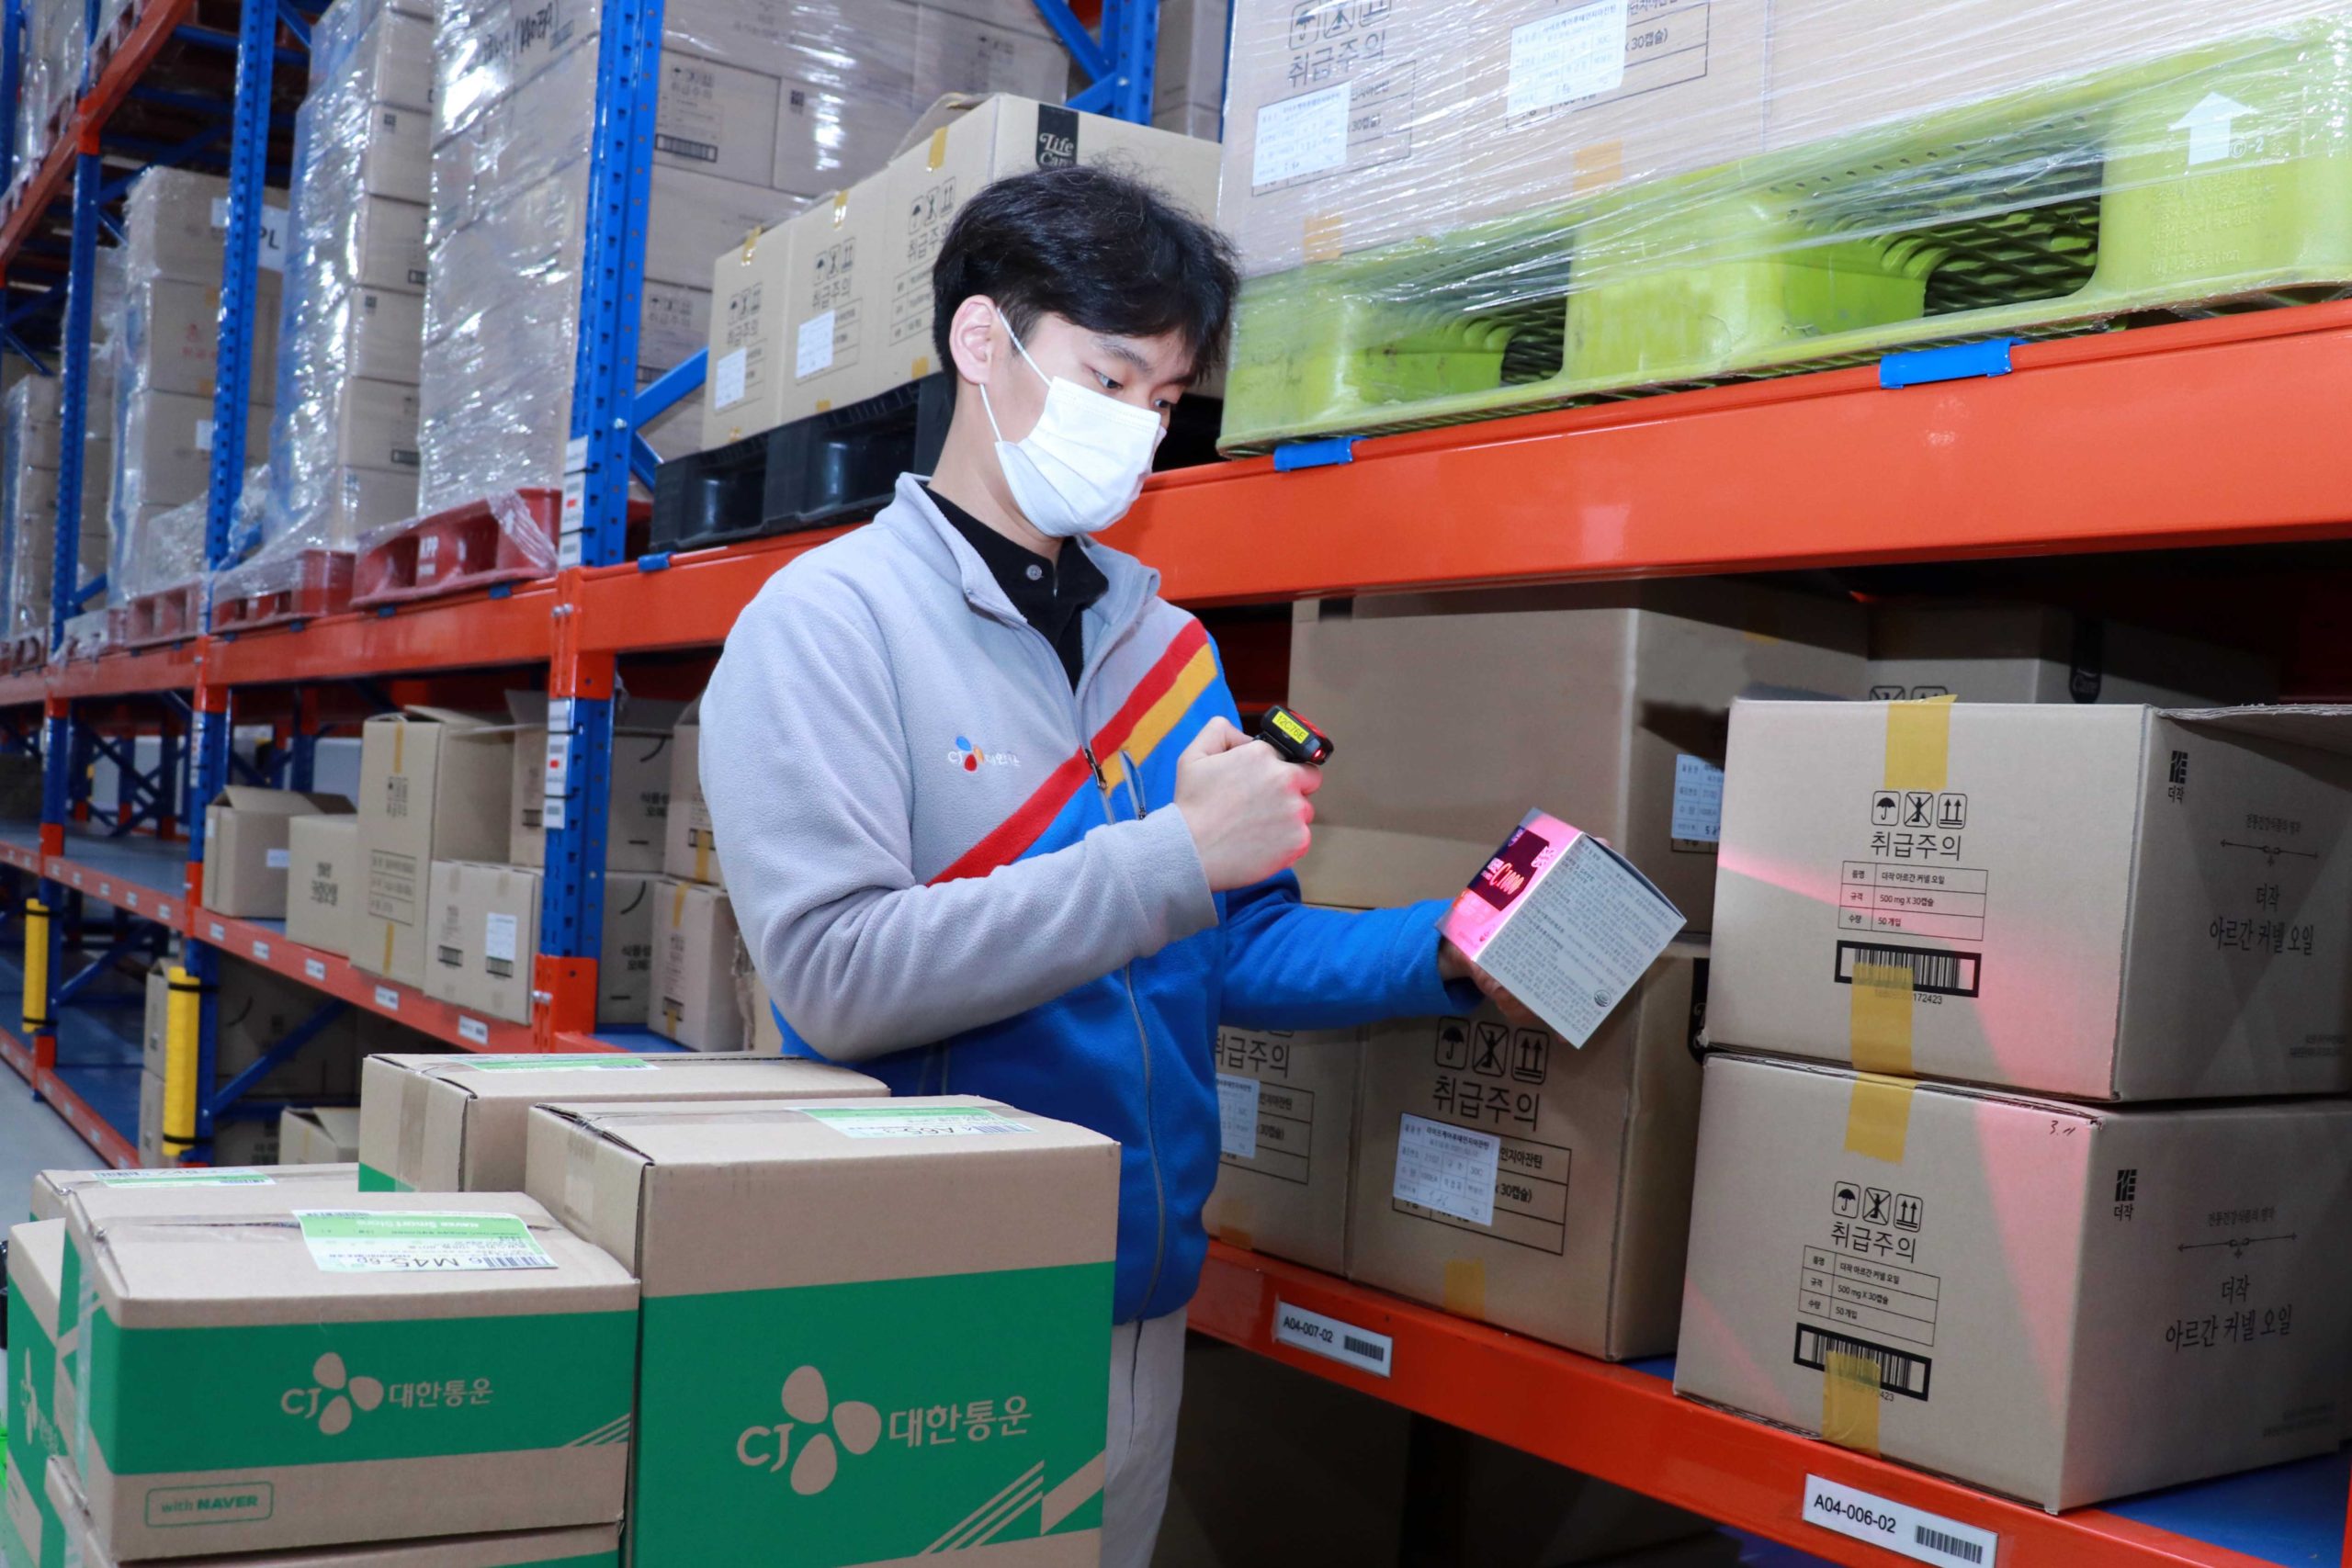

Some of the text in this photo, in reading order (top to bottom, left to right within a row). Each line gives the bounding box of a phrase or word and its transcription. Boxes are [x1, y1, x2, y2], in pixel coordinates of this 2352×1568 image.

[1288, 29, 1385, 87] 취급주의
[1039, 133, 1074, 156] Life
[1871, 831, 1962, 861] 취급주의
[1880, 894, 1893, 903] 500
[1894, 897, 1905, 906] mg
[2256, 883, 2280, 911] 더작
[1878, 917, 1887, 925] 50
[2210, 917, 2253, 951] 아르간
[2288, 924, 2314, 956] 오일
[1432, 1075, 1540, 1132] 취급주의
[1498, 1147, 1544, 1169] 인지아잔틴
[2113, 1203, 2133, 1222] 더작
[1831, 1221, 1916, 1263] 취급주의
[1838, 1284, 1850, 1294] 500
[1851, 1290, 1861, 1300] mg
[2222, 1274, 2250, 1304] 더작
[1836, 1306, 1845, 1315] 50
[1283, 1315, 1333, 1343] A04-007-02
[2165, 1303, 2292, 1352] 아르간 커넬 오일
[281, 1378, 493, 1418] CJ 대한통운
[737, 1395, 1032, 1473] CJ 대한통운
[198, 1495, 258, 1511] NAVER
[1814, 1494, 1896, 1533] A04-006-02
